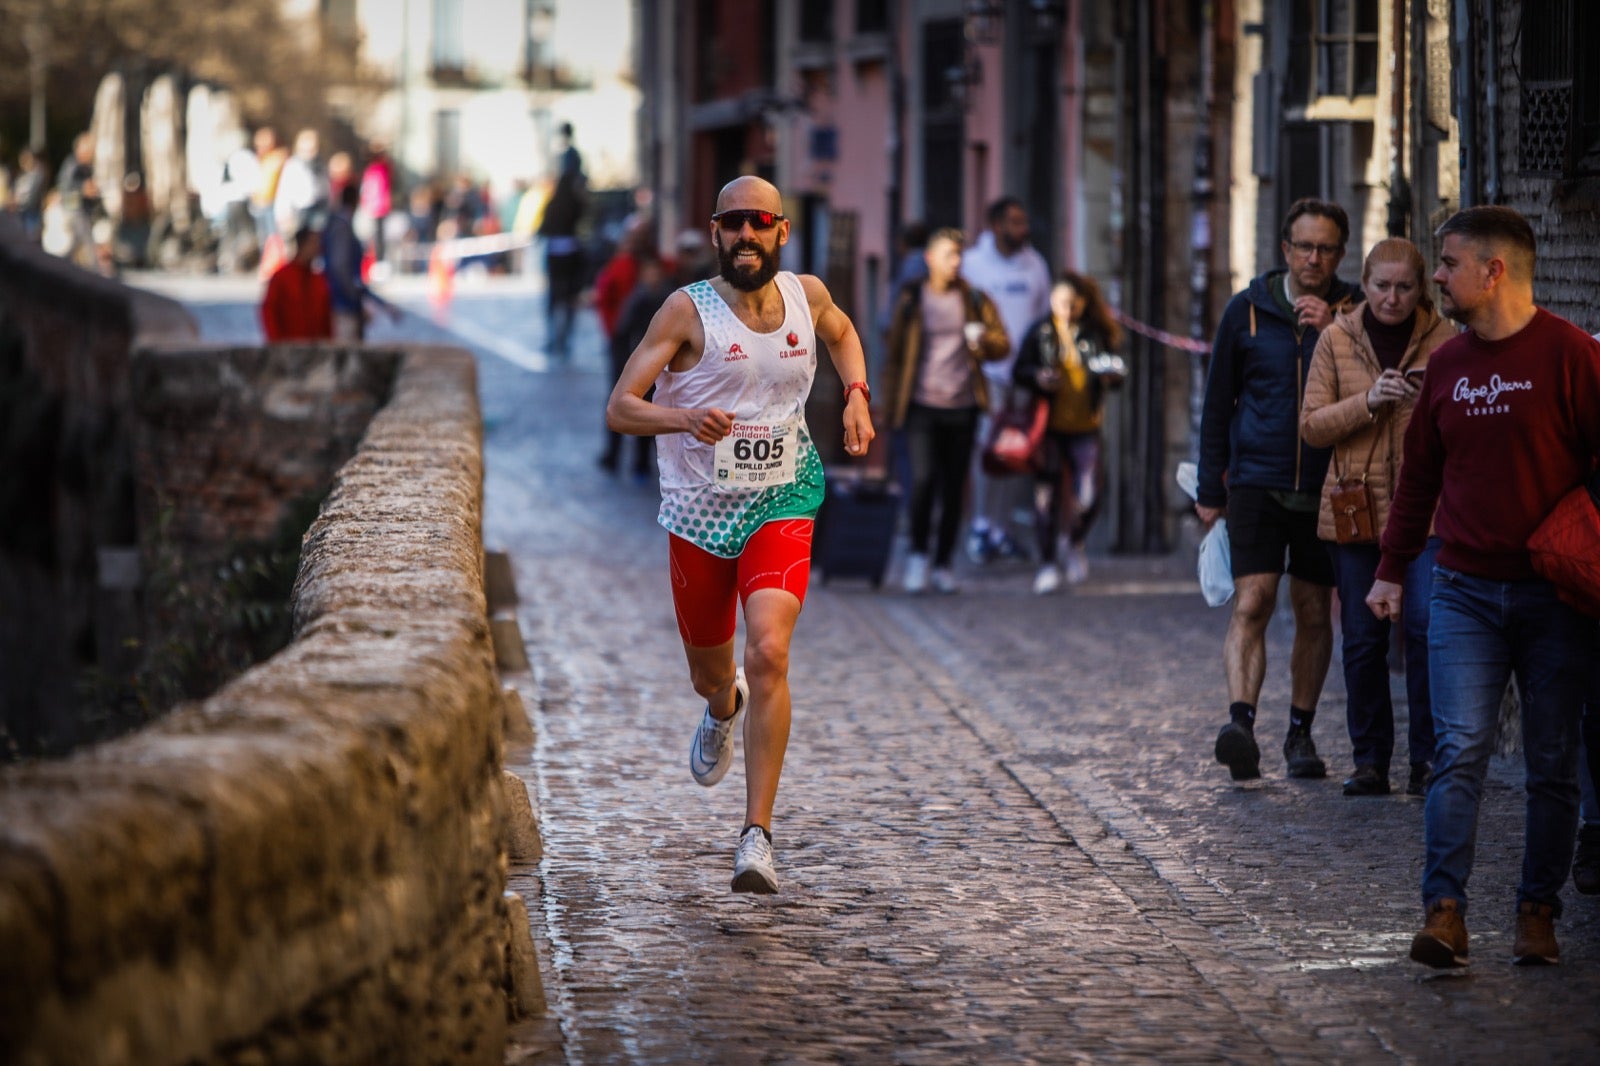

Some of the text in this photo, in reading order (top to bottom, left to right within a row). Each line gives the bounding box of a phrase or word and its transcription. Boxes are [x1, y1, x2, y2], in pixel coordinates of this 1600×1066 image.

[1453, 374, 1532, 404] Pepe Jeans
[1466, 404, 1510, 416] LONDON
[733, 423, 770, 432] Carrera
[732, 430, 771, 439] Solidaria
[734, 438, 784, 461] 605
